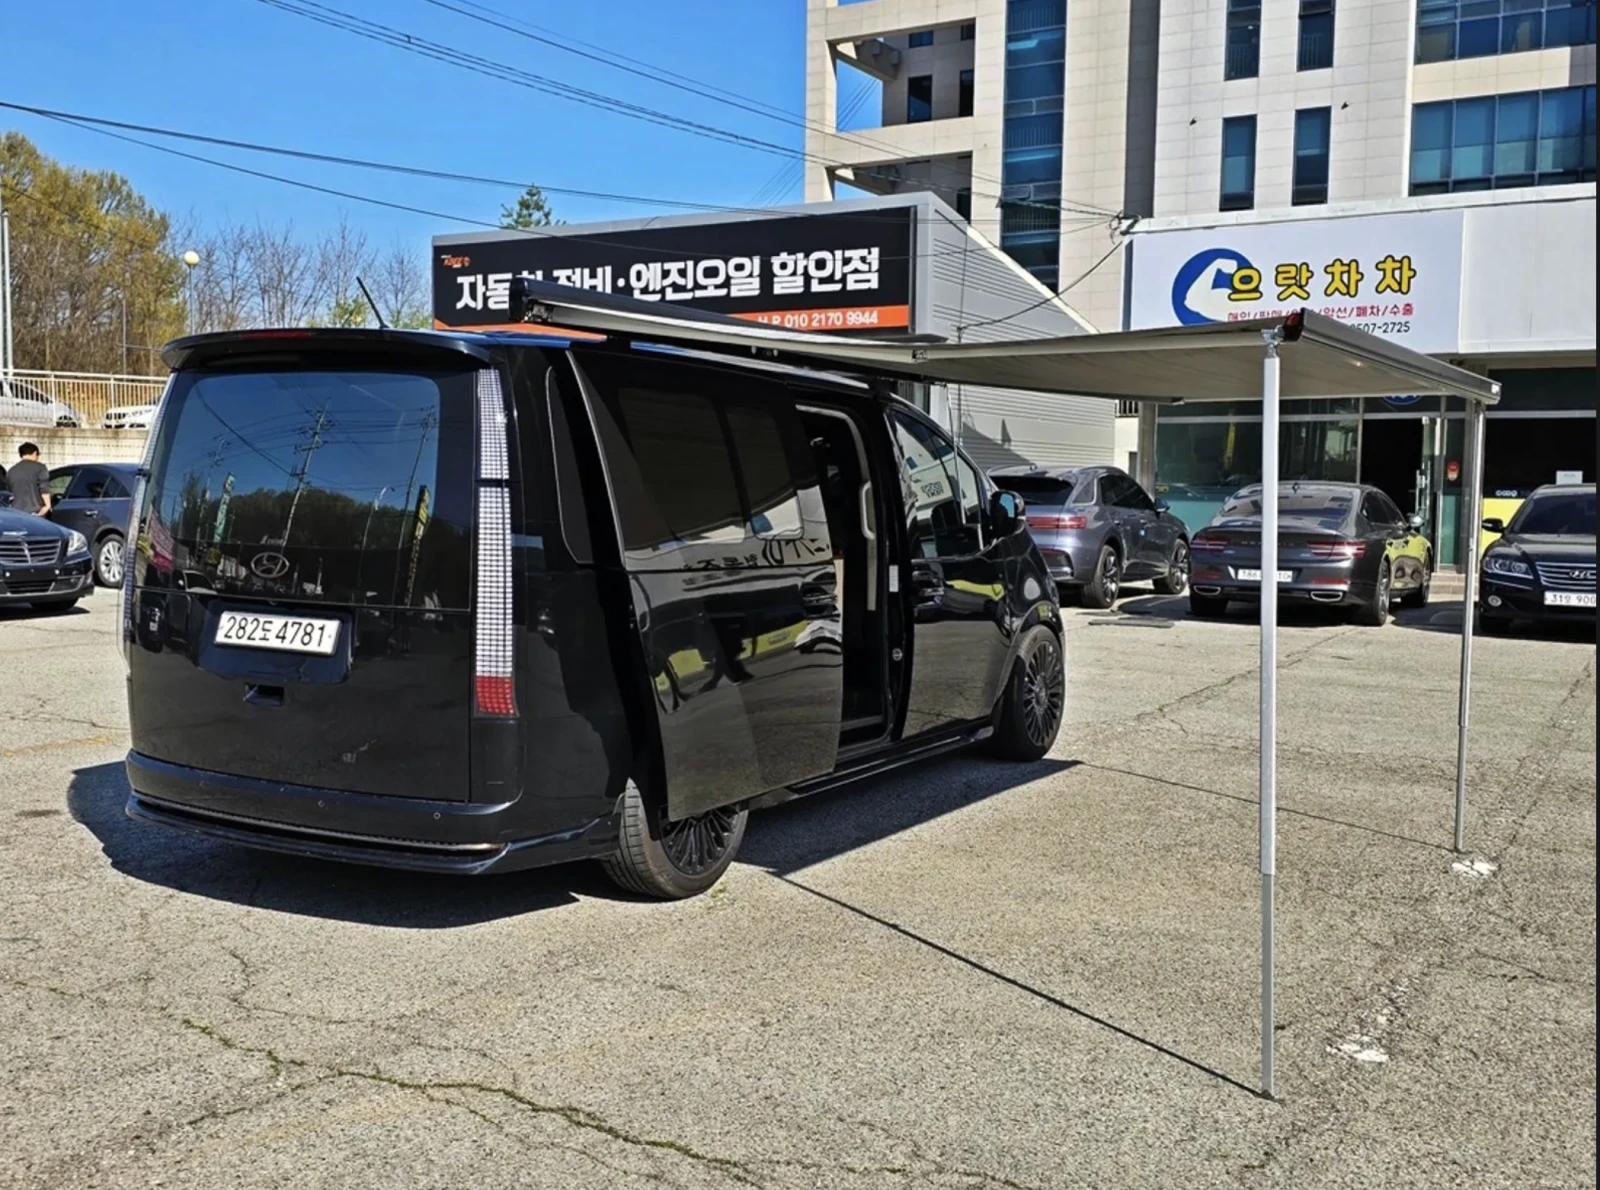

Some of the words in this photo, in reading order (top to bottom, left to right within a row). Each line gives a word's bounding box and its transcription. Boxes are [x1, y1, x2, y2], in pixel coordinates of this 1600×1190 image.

[771, 247, 879, 294] 할인점
[1227, 254, 1416, 302] 으랏차차
[784, 313, 808, 327] 010
[811, 311, 843, 326] 2170
[846, 309, 878, 324] 9944
